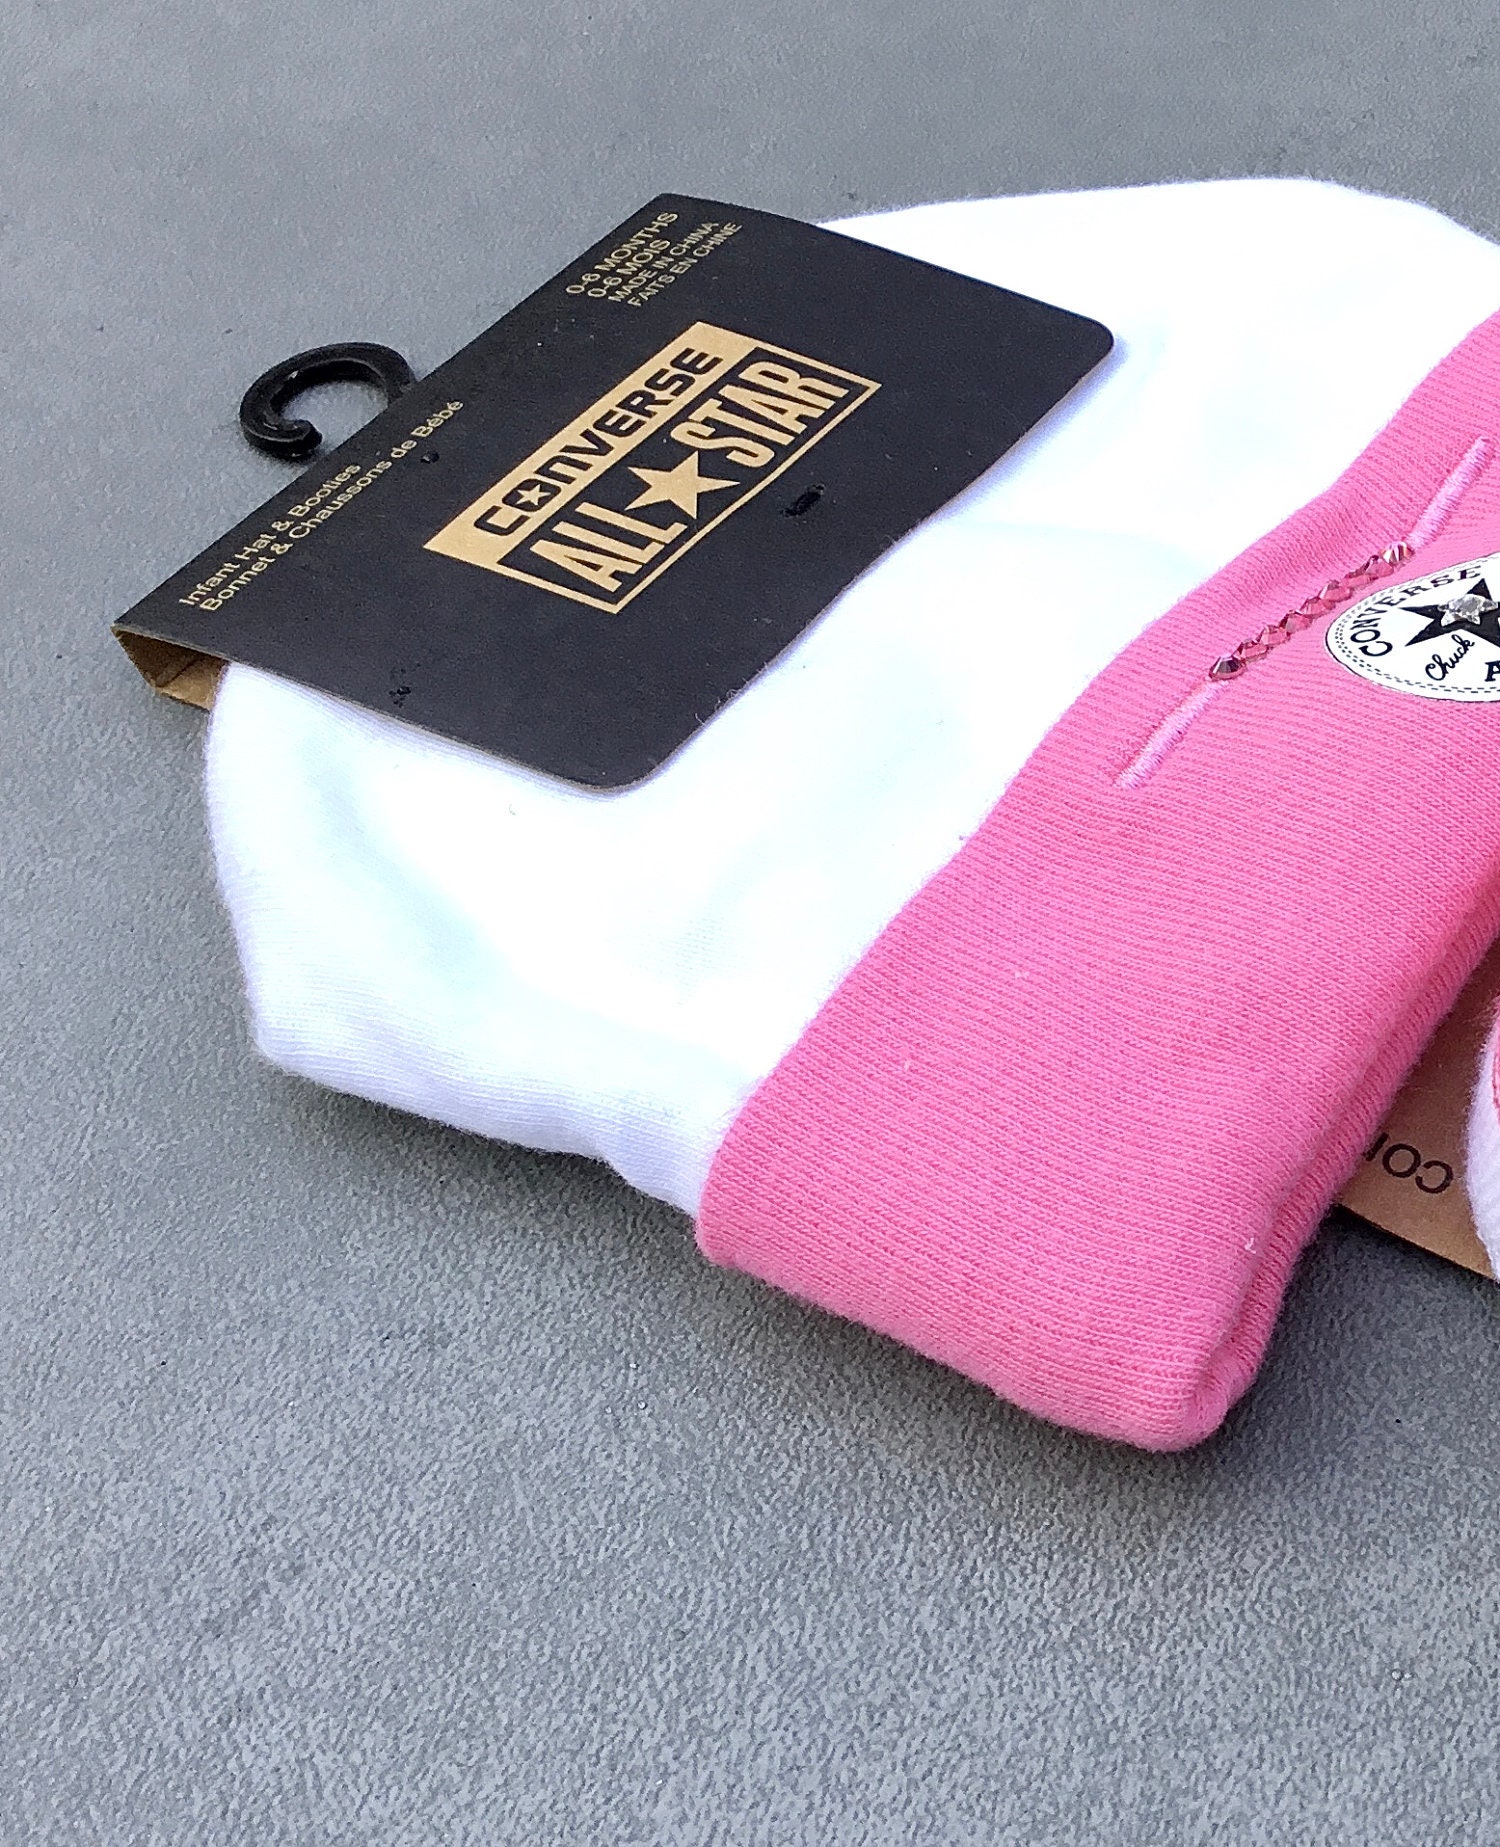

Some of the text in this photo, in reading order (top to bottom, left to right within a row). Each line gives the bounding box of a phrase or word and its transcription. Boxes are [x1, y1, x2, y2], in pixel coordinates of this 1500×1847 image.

[587, 239, 671, 298] 0-6 MOIS
[594, 212, 679, 271] MONTHS
[608, 222, 720, 302] MADE IN CHINA
[627, 222, 743, 307] FAITS EN CHINE
[473, 347, 724, 536] CONVERSE
[529, 360, 850, 593] ALL STAR
[178, 463, 362, 606] Infant Hat & Booties
[199, 400, 465, 612] Bonnet & Chaussons de Bébé
[1349, 564, 1482, 658] CONVERSE
[1424, 633, 1476, 682] Chuck
